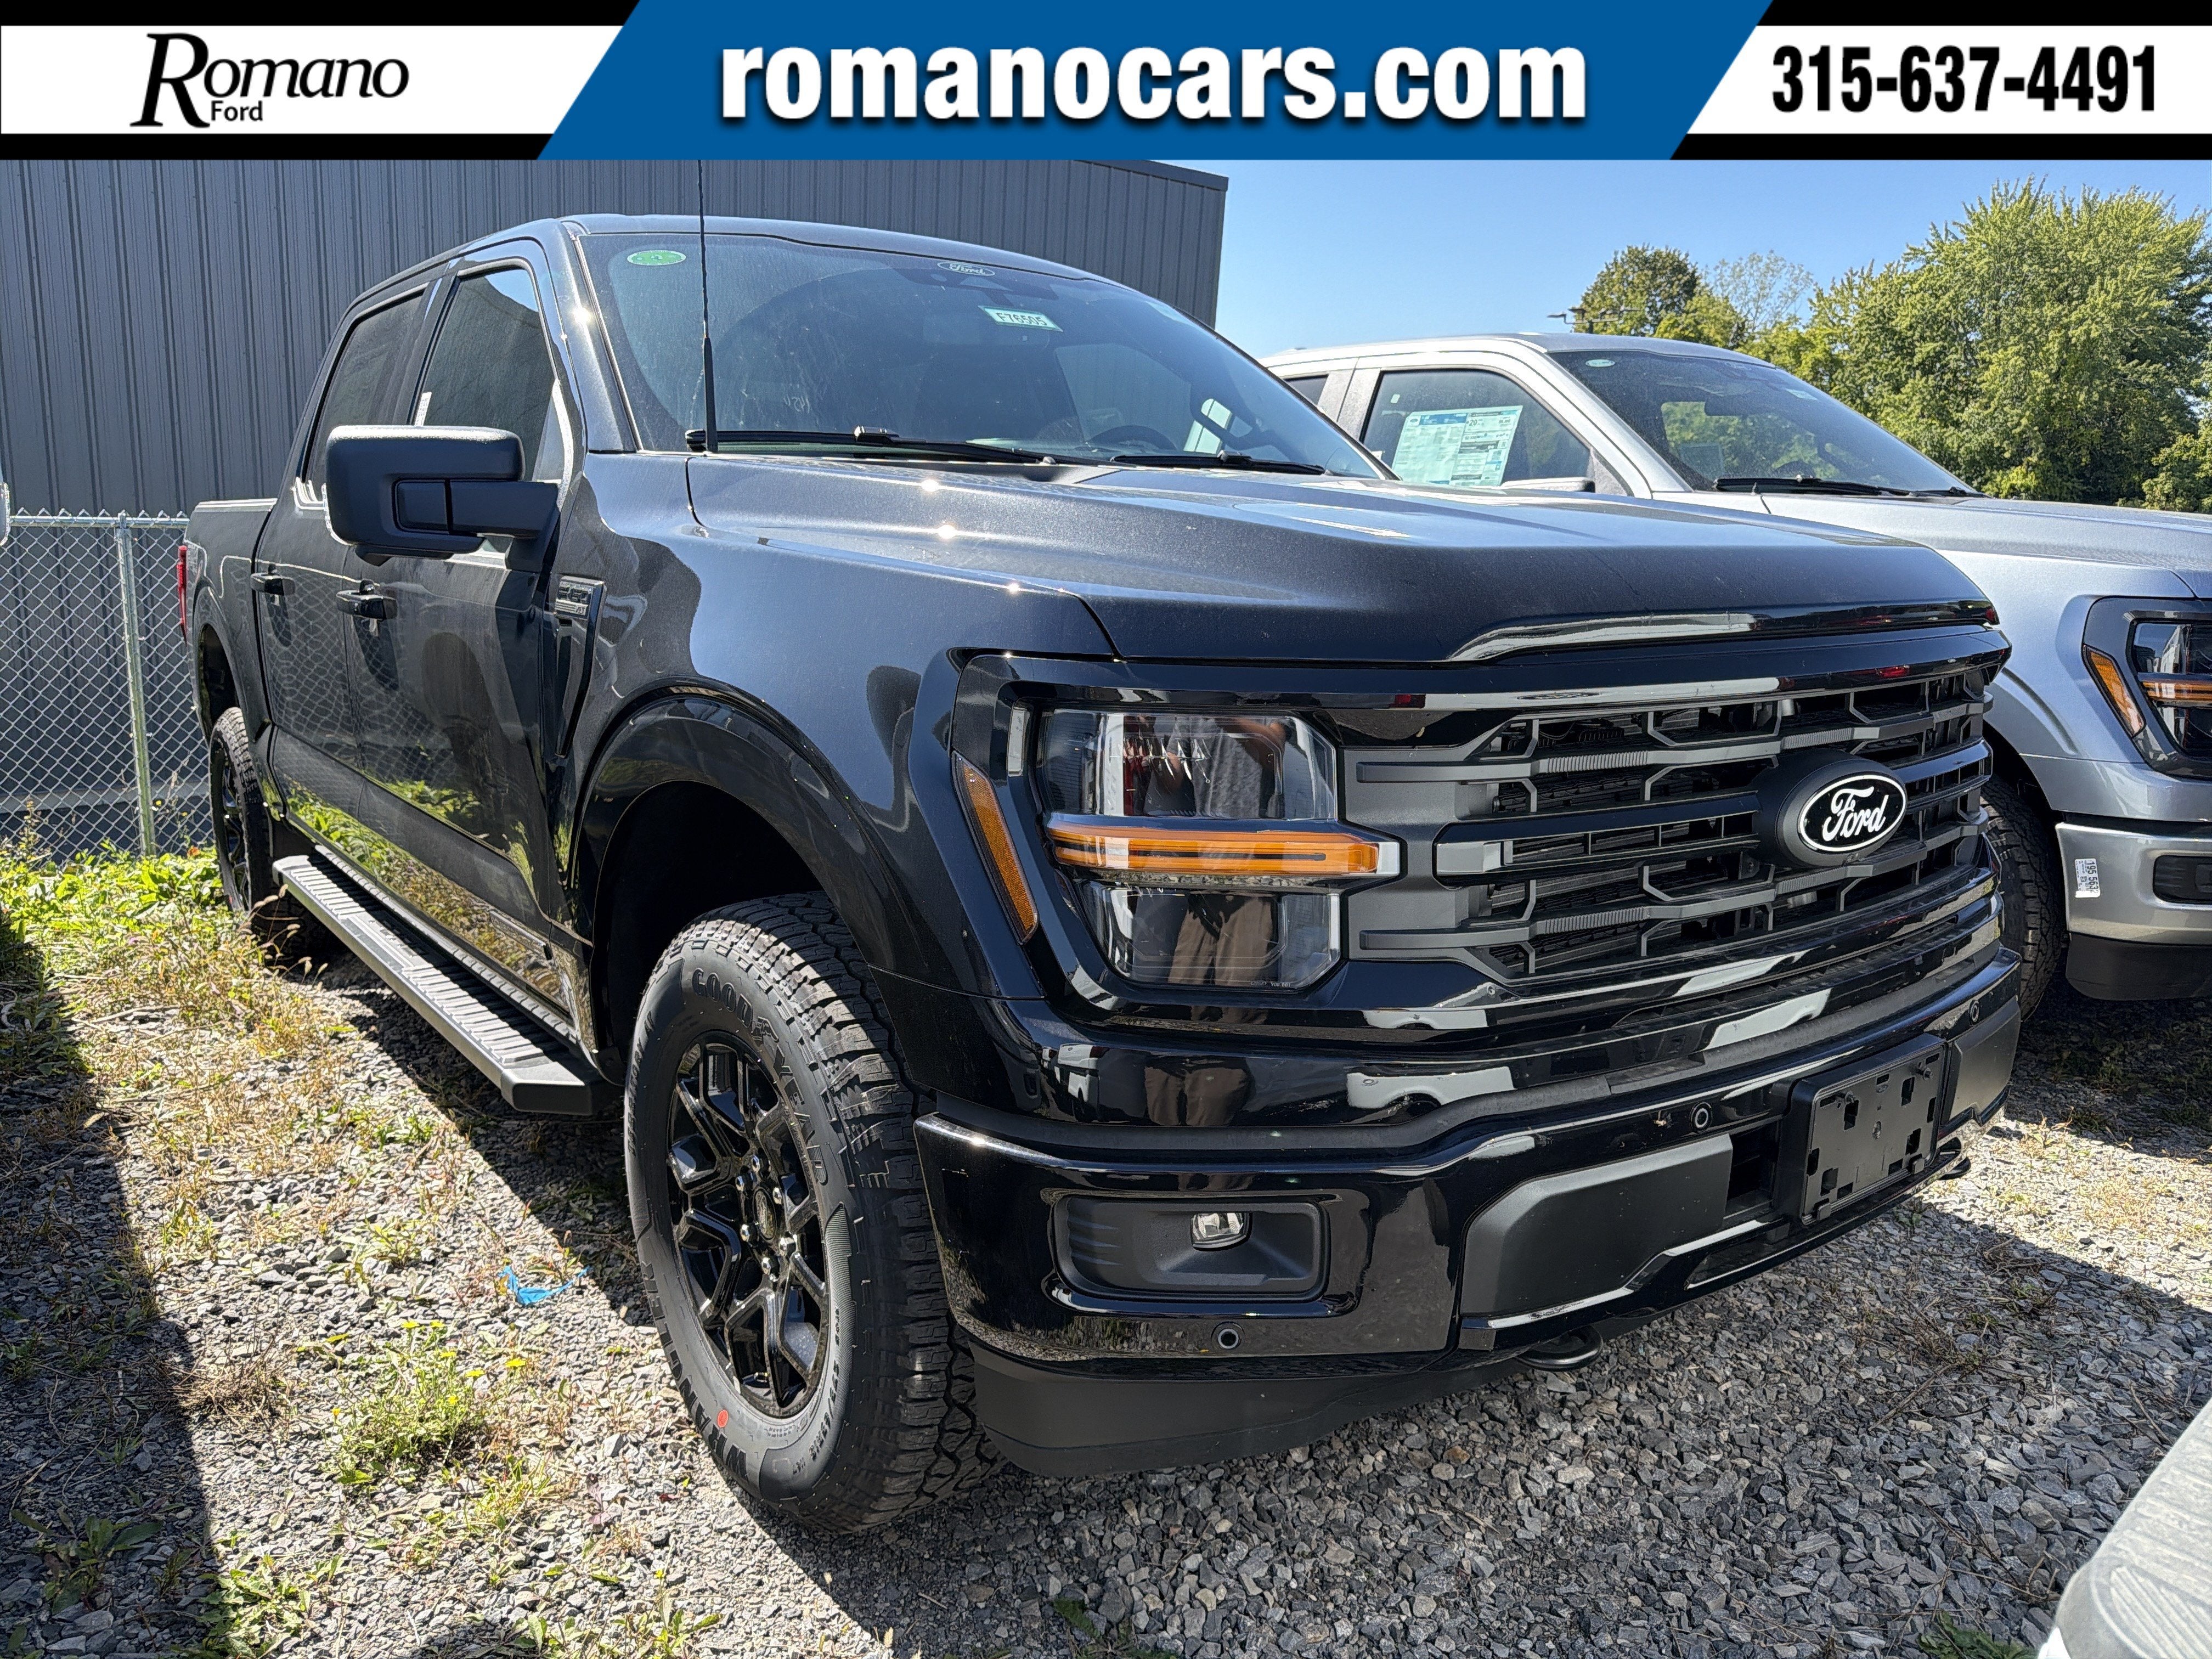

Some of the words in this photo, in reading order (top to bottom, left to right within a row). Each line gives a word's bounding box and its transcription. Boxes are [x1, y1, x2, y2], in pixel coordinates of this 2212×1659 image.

[949, 263, 986, 274] Ford
[995, 312, 1047, 326] F76505
[1822, 786, 1889, 842] Ford
[2086, 861, 2097, 874] 195
[641, 1261, 748, 1480] WRANGLER
